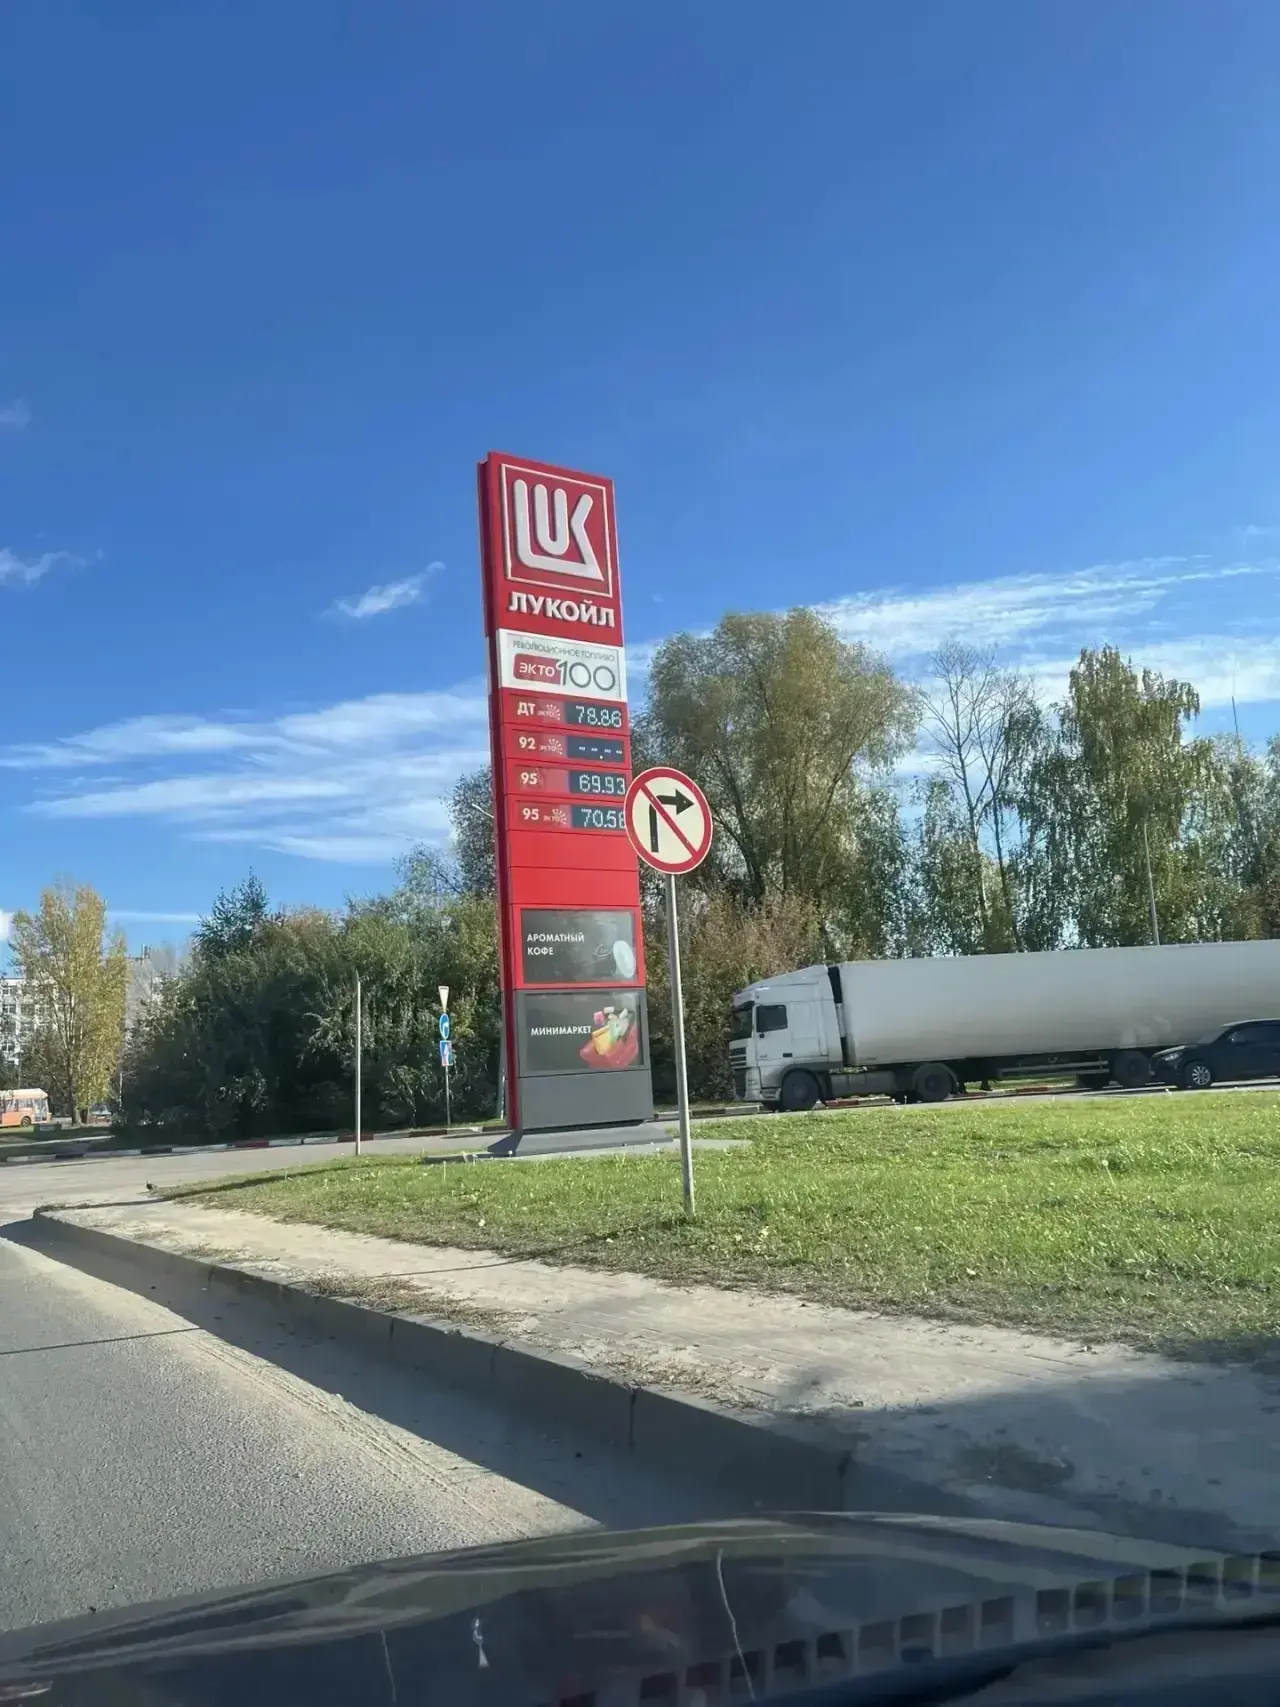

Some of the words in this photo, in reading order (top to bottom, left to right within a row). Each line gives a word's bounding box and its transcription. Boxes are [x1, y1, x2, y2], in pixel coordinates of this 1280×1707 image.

[508, 591, 615, 628] ЛУКОЙЛ
[519, 662, 555, 677] ЭКТО
[557, 660, 616, 691] 100
[517, 702, 536, 717] ДТ
[576, 705, 622, 728] 78.86
[519, 736, 536, 749] 92
[521, 773, 538, 785] 95
[579, 774, 626, 795] 69.93
[522, 808, 539, 821] 95
[526, 932, 585, 943] АРОМАТНЫЙ
[527, 946, 554, 956] КОФЕ
[530, 1025, 592, 1036] МИНИМАРКЕТ
